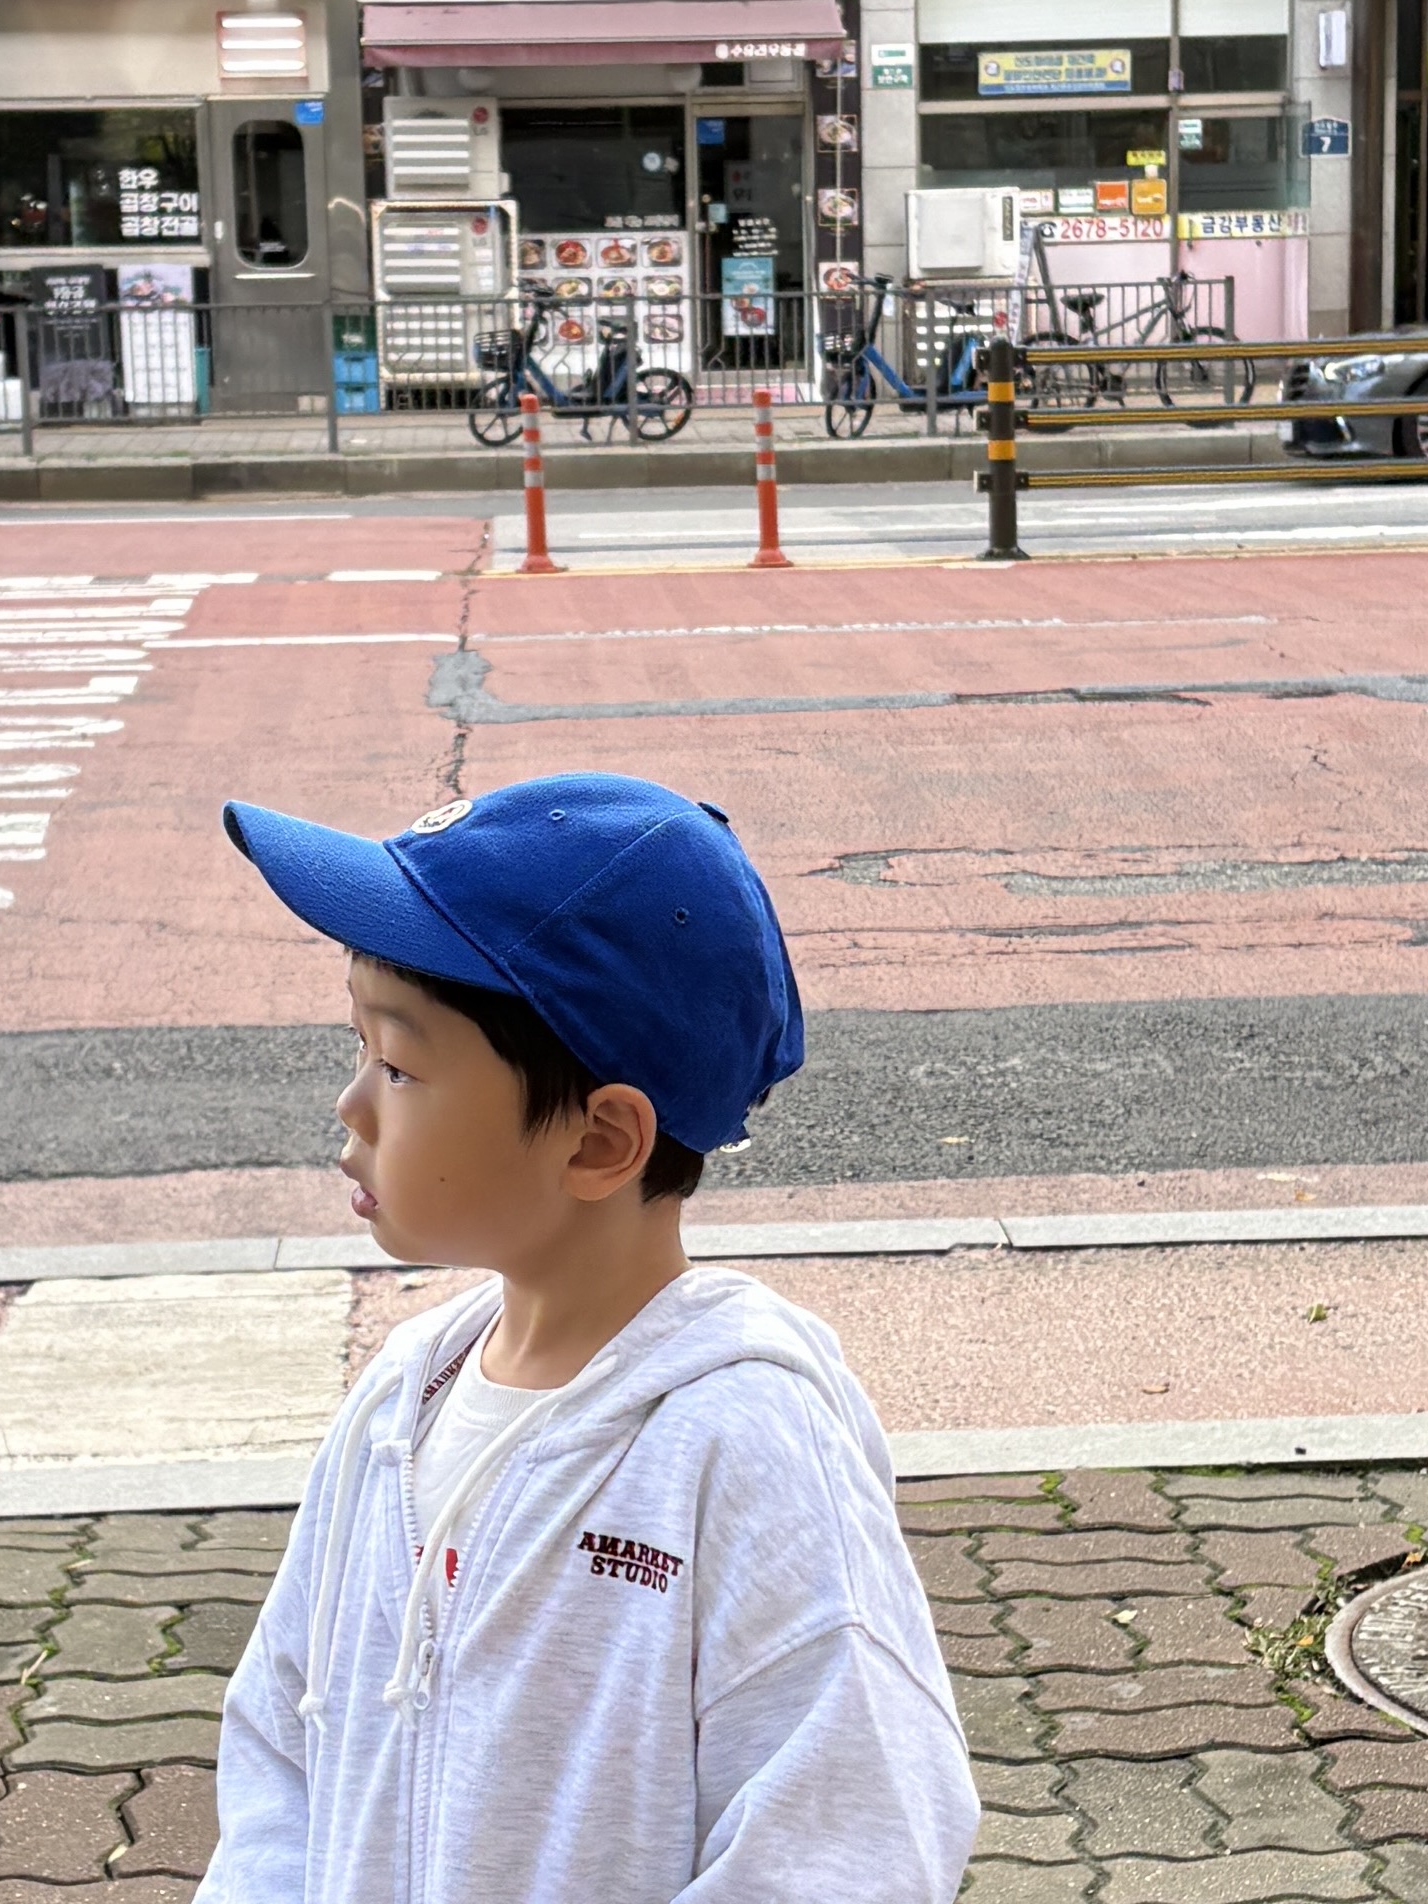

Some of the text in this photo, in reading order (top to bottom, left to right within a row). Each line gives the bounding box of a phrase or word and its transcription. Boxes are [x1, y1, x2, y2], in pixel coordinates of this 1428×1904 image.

[1319, 136, 1331, 153] 7
[119, 191, 199, 214] 곱창구이
[1060, 217, 1165, 240] 2678-5120
[1200, 213, 1283, 235] 금강부동산
[577, 1530, 684, 1577] AMARKET
[590, 1554, 669, 1594] STUDIO
